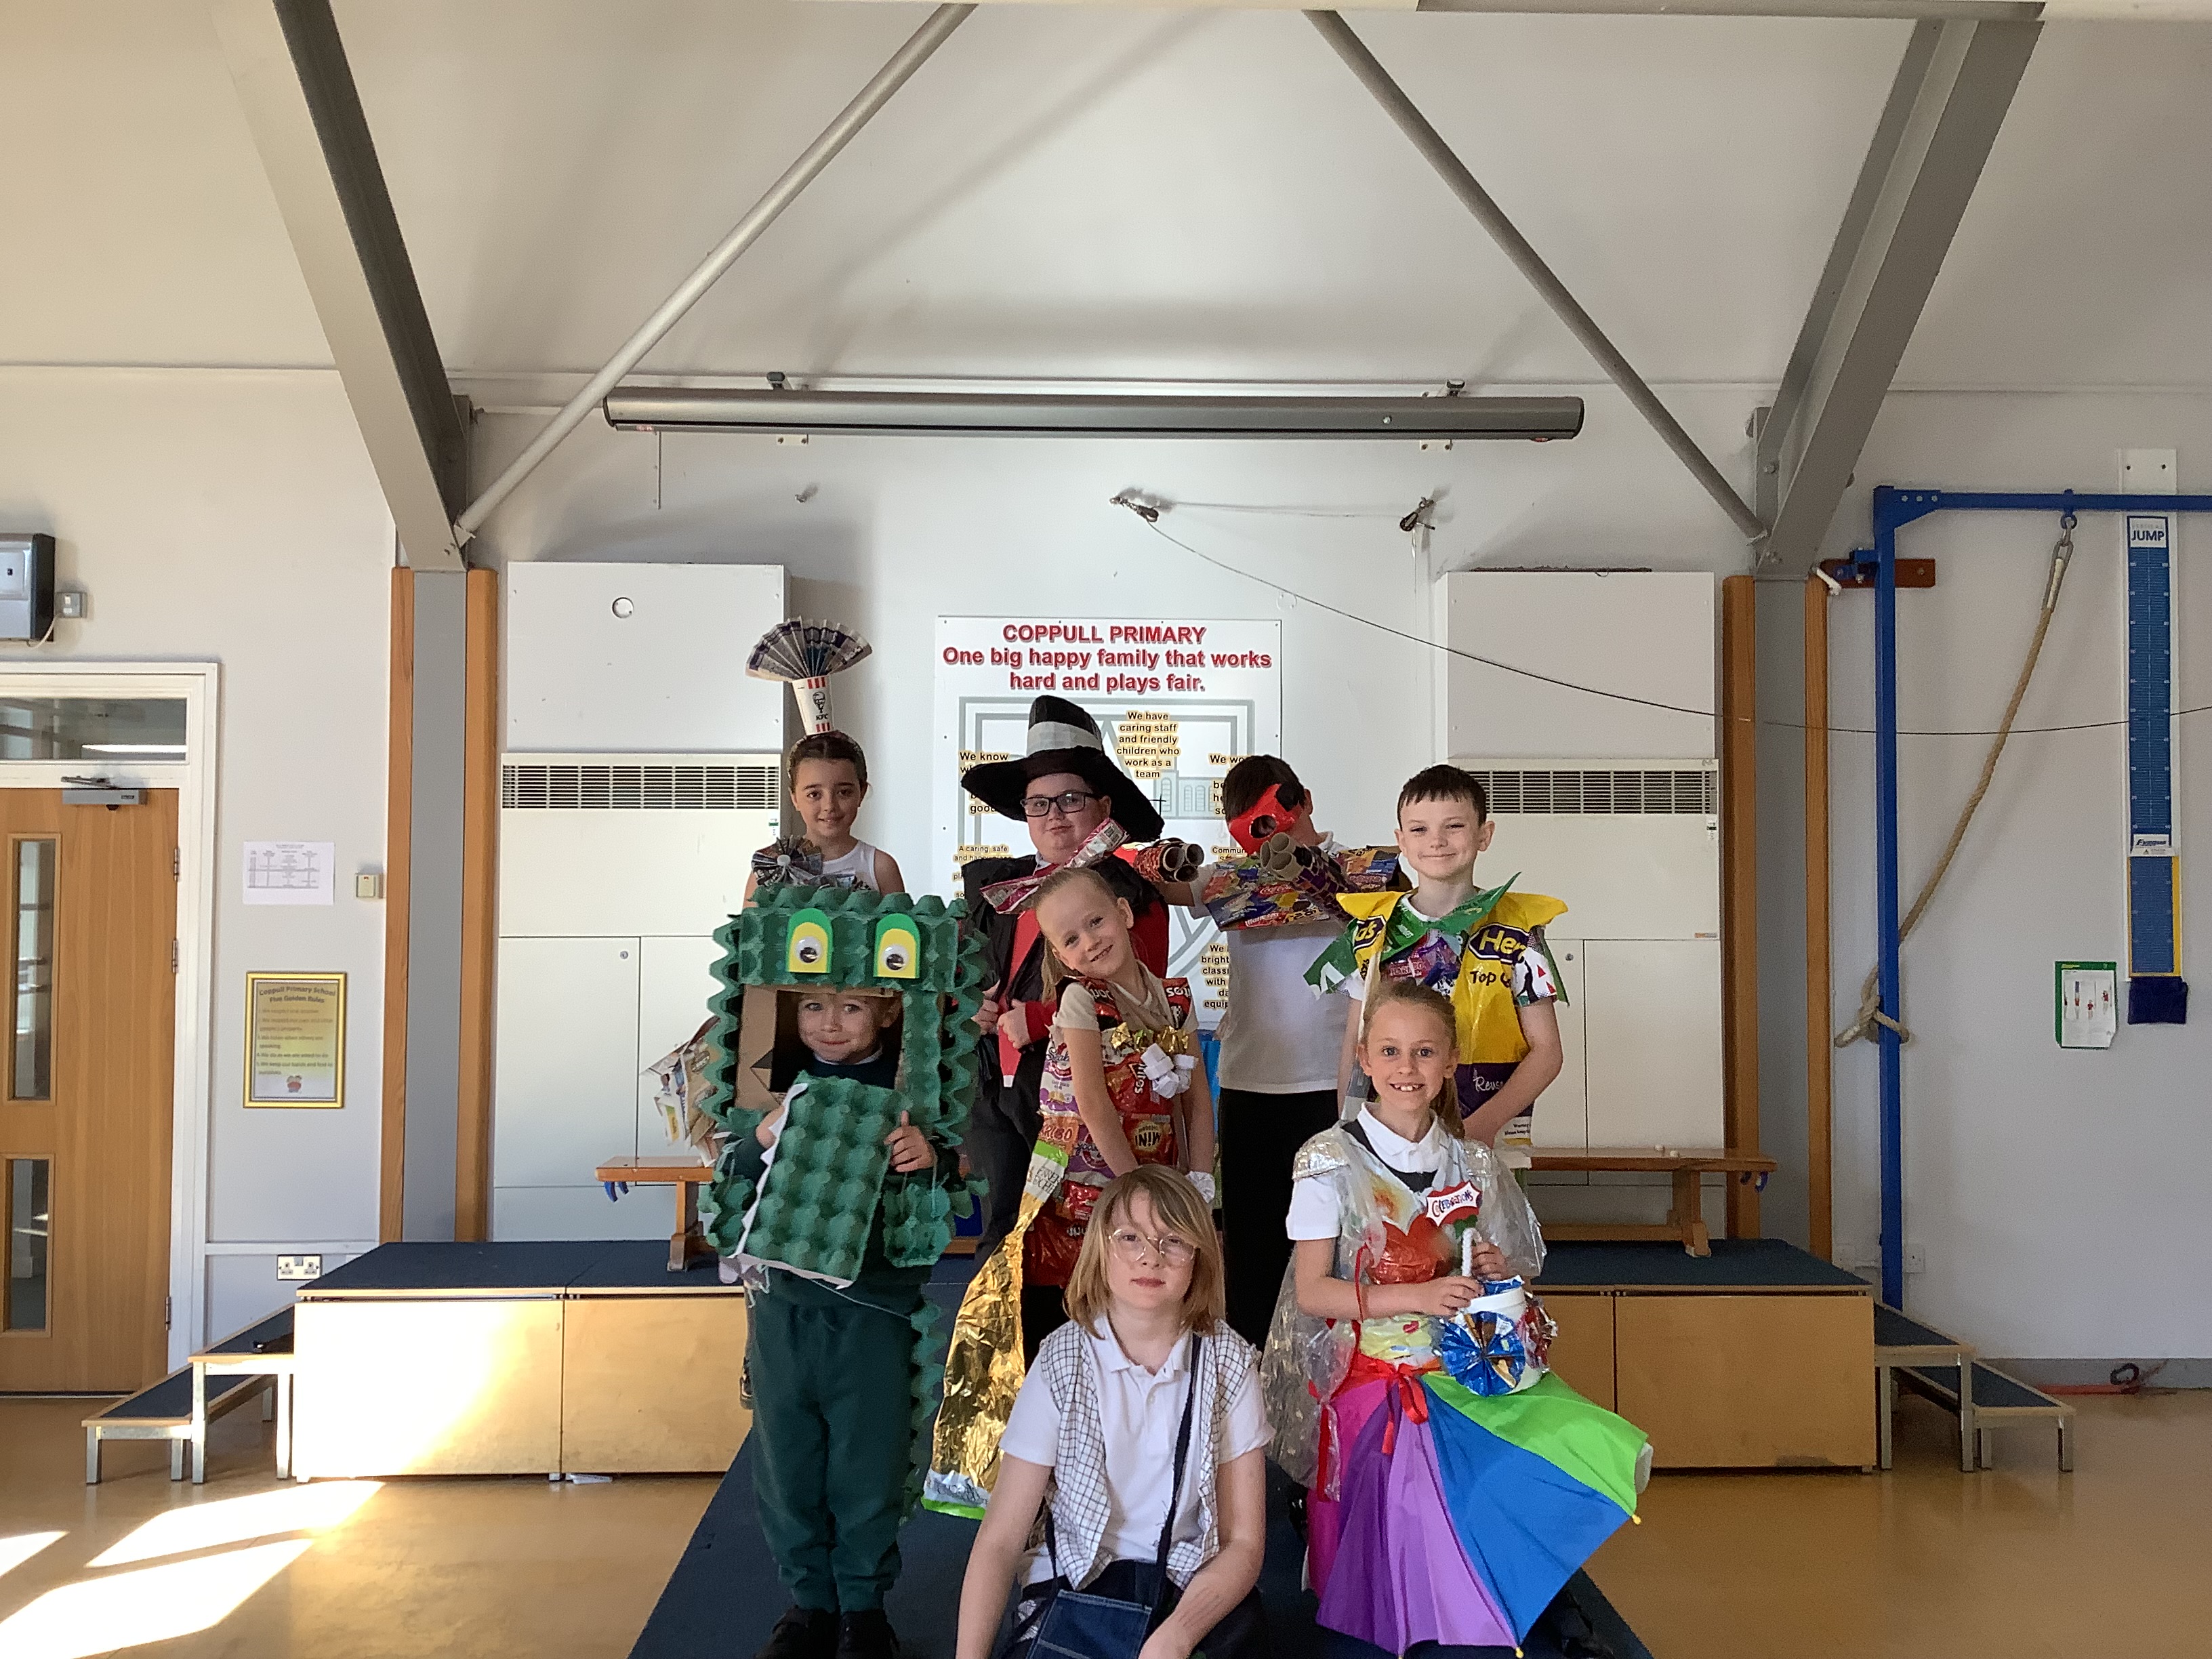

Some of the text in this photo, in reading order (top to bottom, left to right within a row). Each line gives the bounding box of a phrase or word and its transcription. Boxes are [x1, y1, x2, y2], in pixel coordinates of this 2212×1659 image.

[2131, 530, 2165, 541] JUMP
[1003, 624, 1207, 644] COPPULL PRIMARY
[943, 647, 1271, 670] One big happy family that works
[1010, 672, 1206, 695] hard and plays fair.
[1128, 712, 1168, 720] We have
[1120, 724, 1177, 733] caring staff
[1140, 735, 1177, 745] friendly
[960, 752, 1008, 761] We know
[1210, 755, 1226, 764] We
[1125, 758, 1148, 766] work
[1202, 956, 1229, 965] bright
[1390, 962, 1423, 977] HARBO
[1470, 971, 1496, 987] Top
